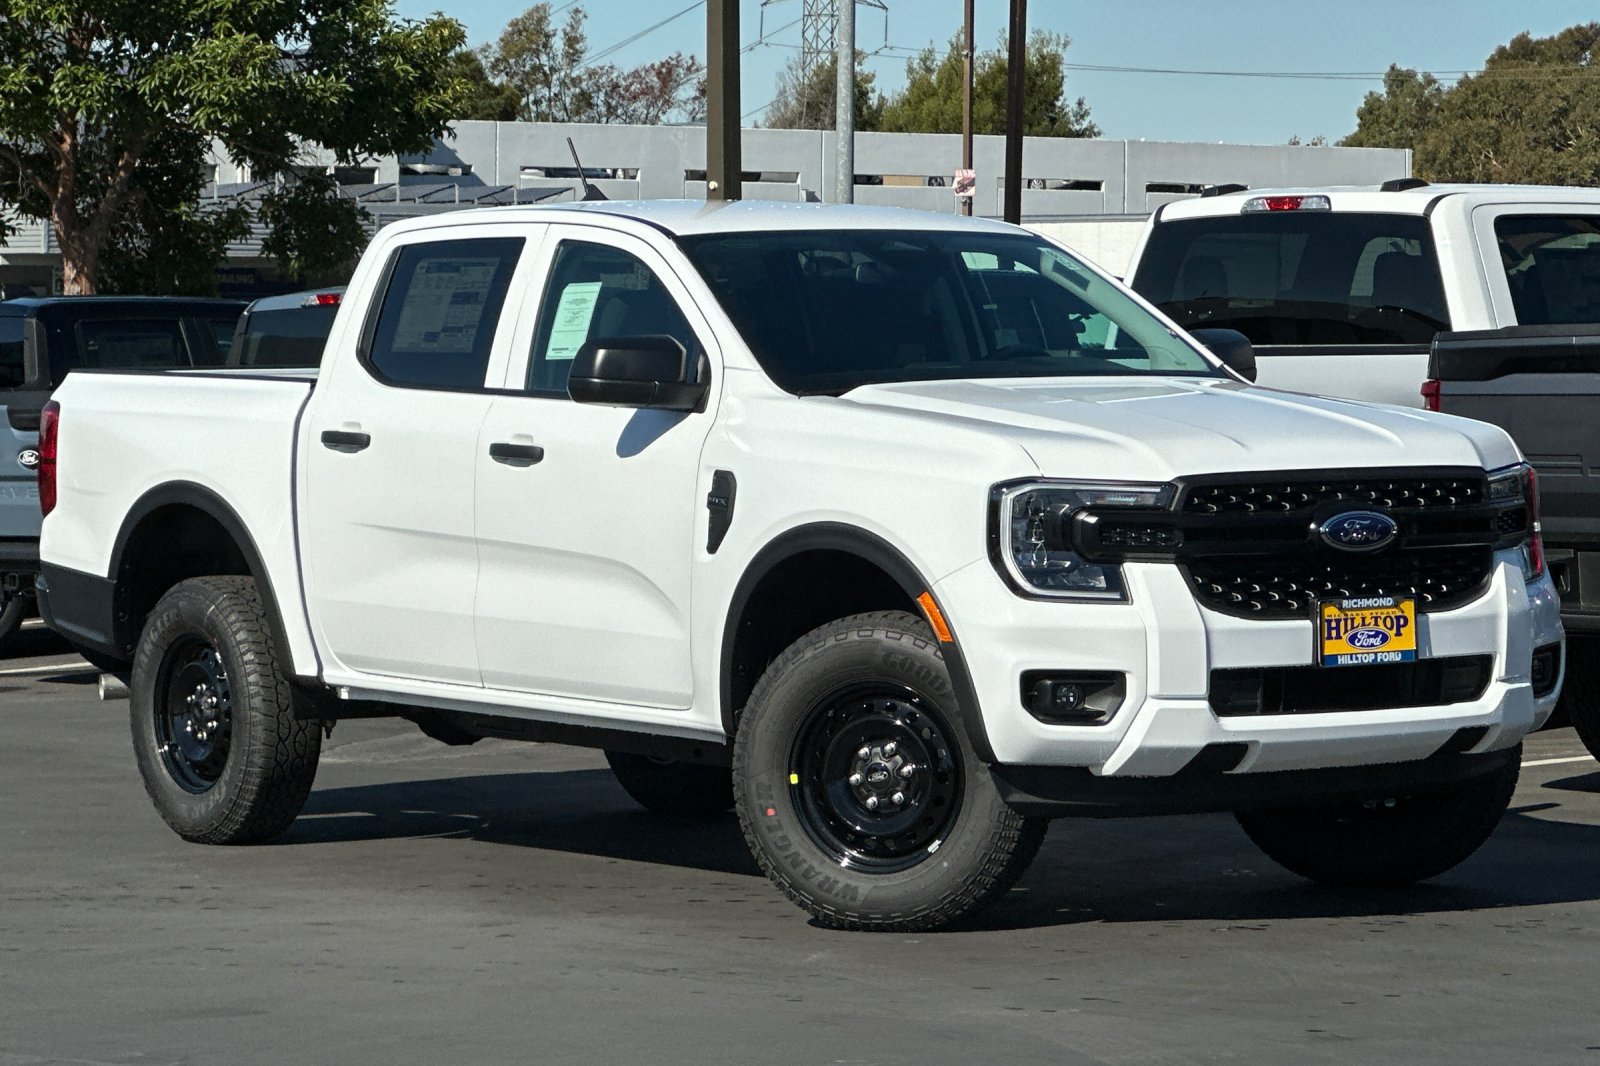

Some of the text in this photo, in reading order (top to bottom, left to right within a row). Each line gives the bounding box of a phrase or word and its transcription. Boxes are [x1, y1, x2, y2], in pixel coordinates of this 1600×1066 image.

[1341, 519, 1382, 542] Ford
[1342, 597, 1393, 608] RICHMOND
[1325, 614, 1409, 641] HILLTOP
[1355, 630, 1383, 647] Ford
[1338, 651, 1402, 664] HILLTOP FORD
